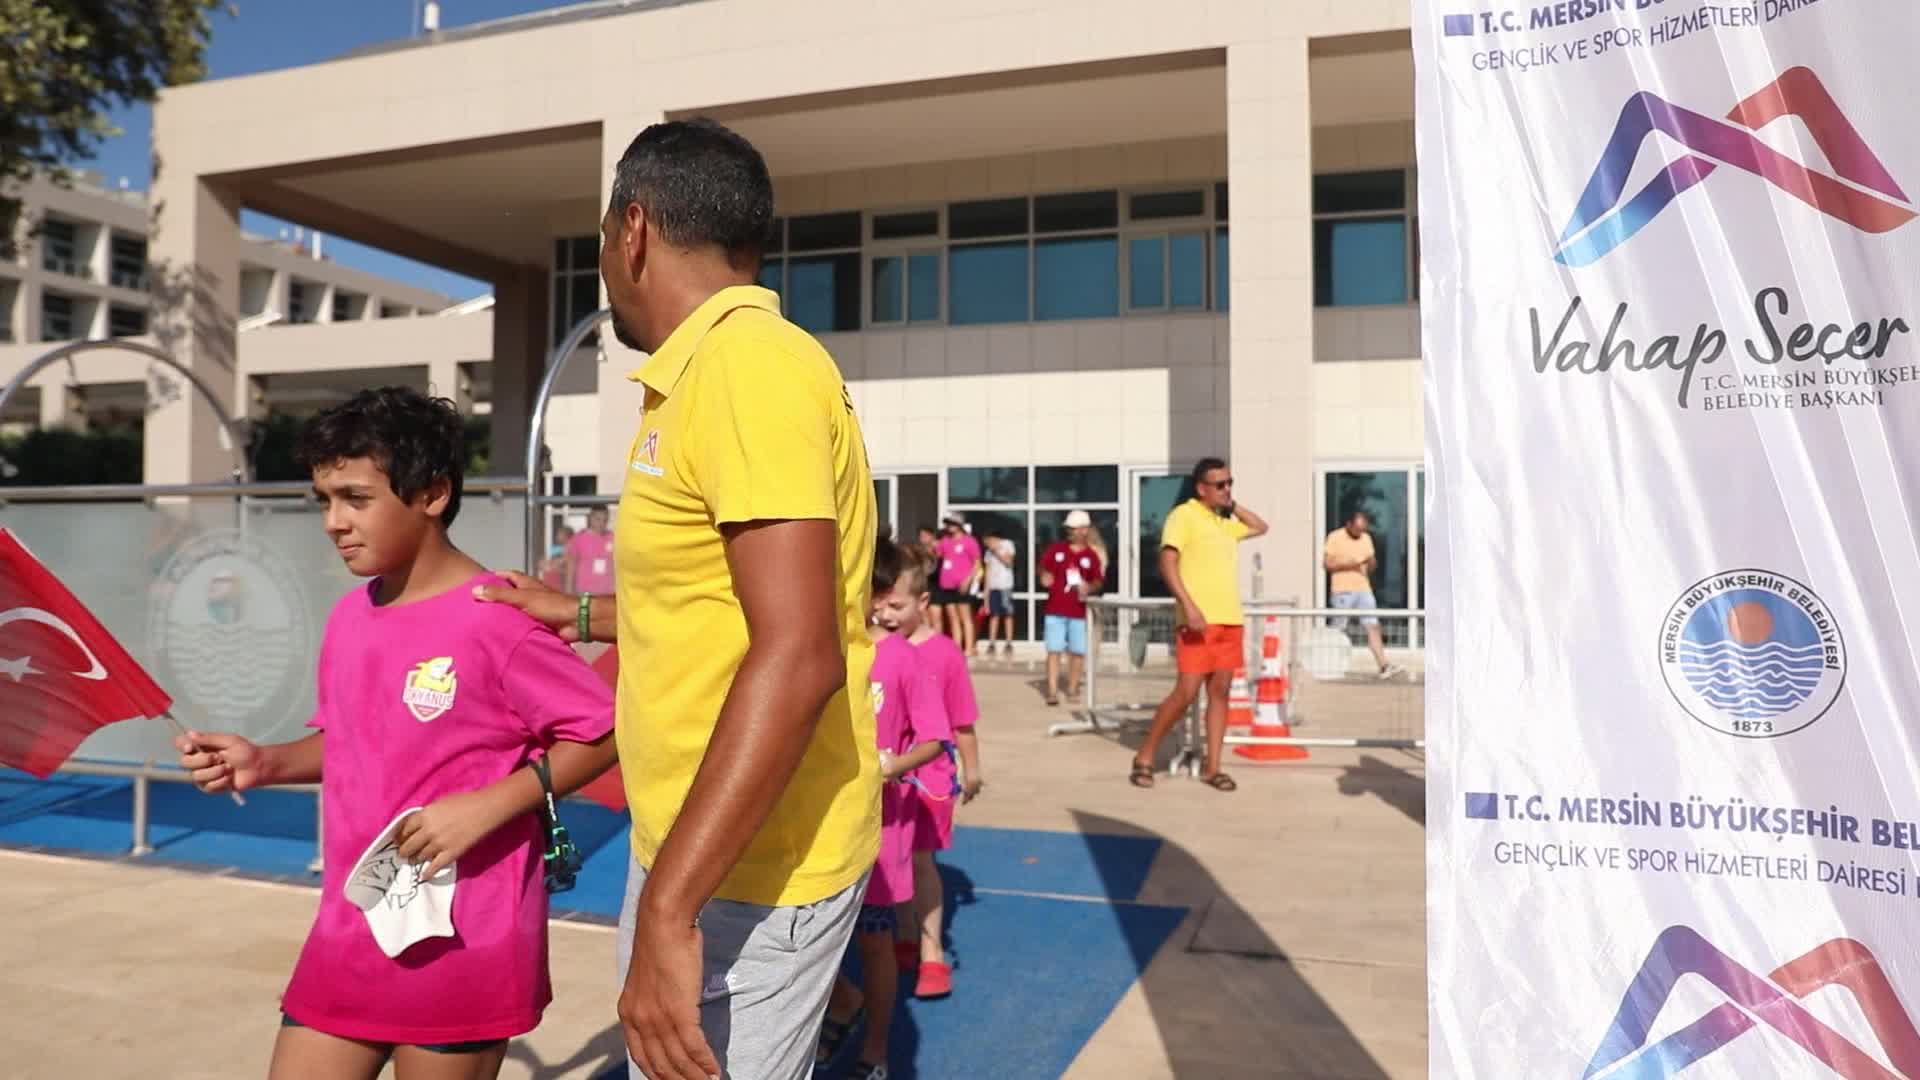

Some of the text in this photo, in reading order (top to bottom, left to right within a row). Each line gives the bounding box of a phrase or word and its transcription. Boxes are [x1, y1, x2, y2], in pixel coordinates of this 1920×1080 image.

[1472, 42, 1559, 73] GENÇLİK
[1563, 39, 1588, 62] VE
[1593, 27, 1643, 56] SPOR
[1650, 1, 1759, 46] HİZMETLERİ
[1479, 11, 1522, 34] T.C.
[1528, 287, 1911, 409] Vahap Seçer
[1701, 374, 1737, 391] T.C.
[1743, 370, 1816, 390] MERSİN
[1703, 389, 1884, 412] BELEDİYE BAŞKANI
[1664, 575, 1841, 671] MERSİN BÜYÜKŞEHİR BELEDİYESİ
[1732, 720, 1774, 733] 1873
[1504, 791, 1920, 850] T.C. MERSİN BÜYÜKŞEHİR BEL
[1494, 840, 1589, 872] GENÇLİK
[1594, 847, 1621, 869] VE
[1627, 847, 1679, 873] SPOR
[1685, 847, 1808, 881] HİZMETLERİ
[1817, 859, 1906, 897] DAİRESİ
